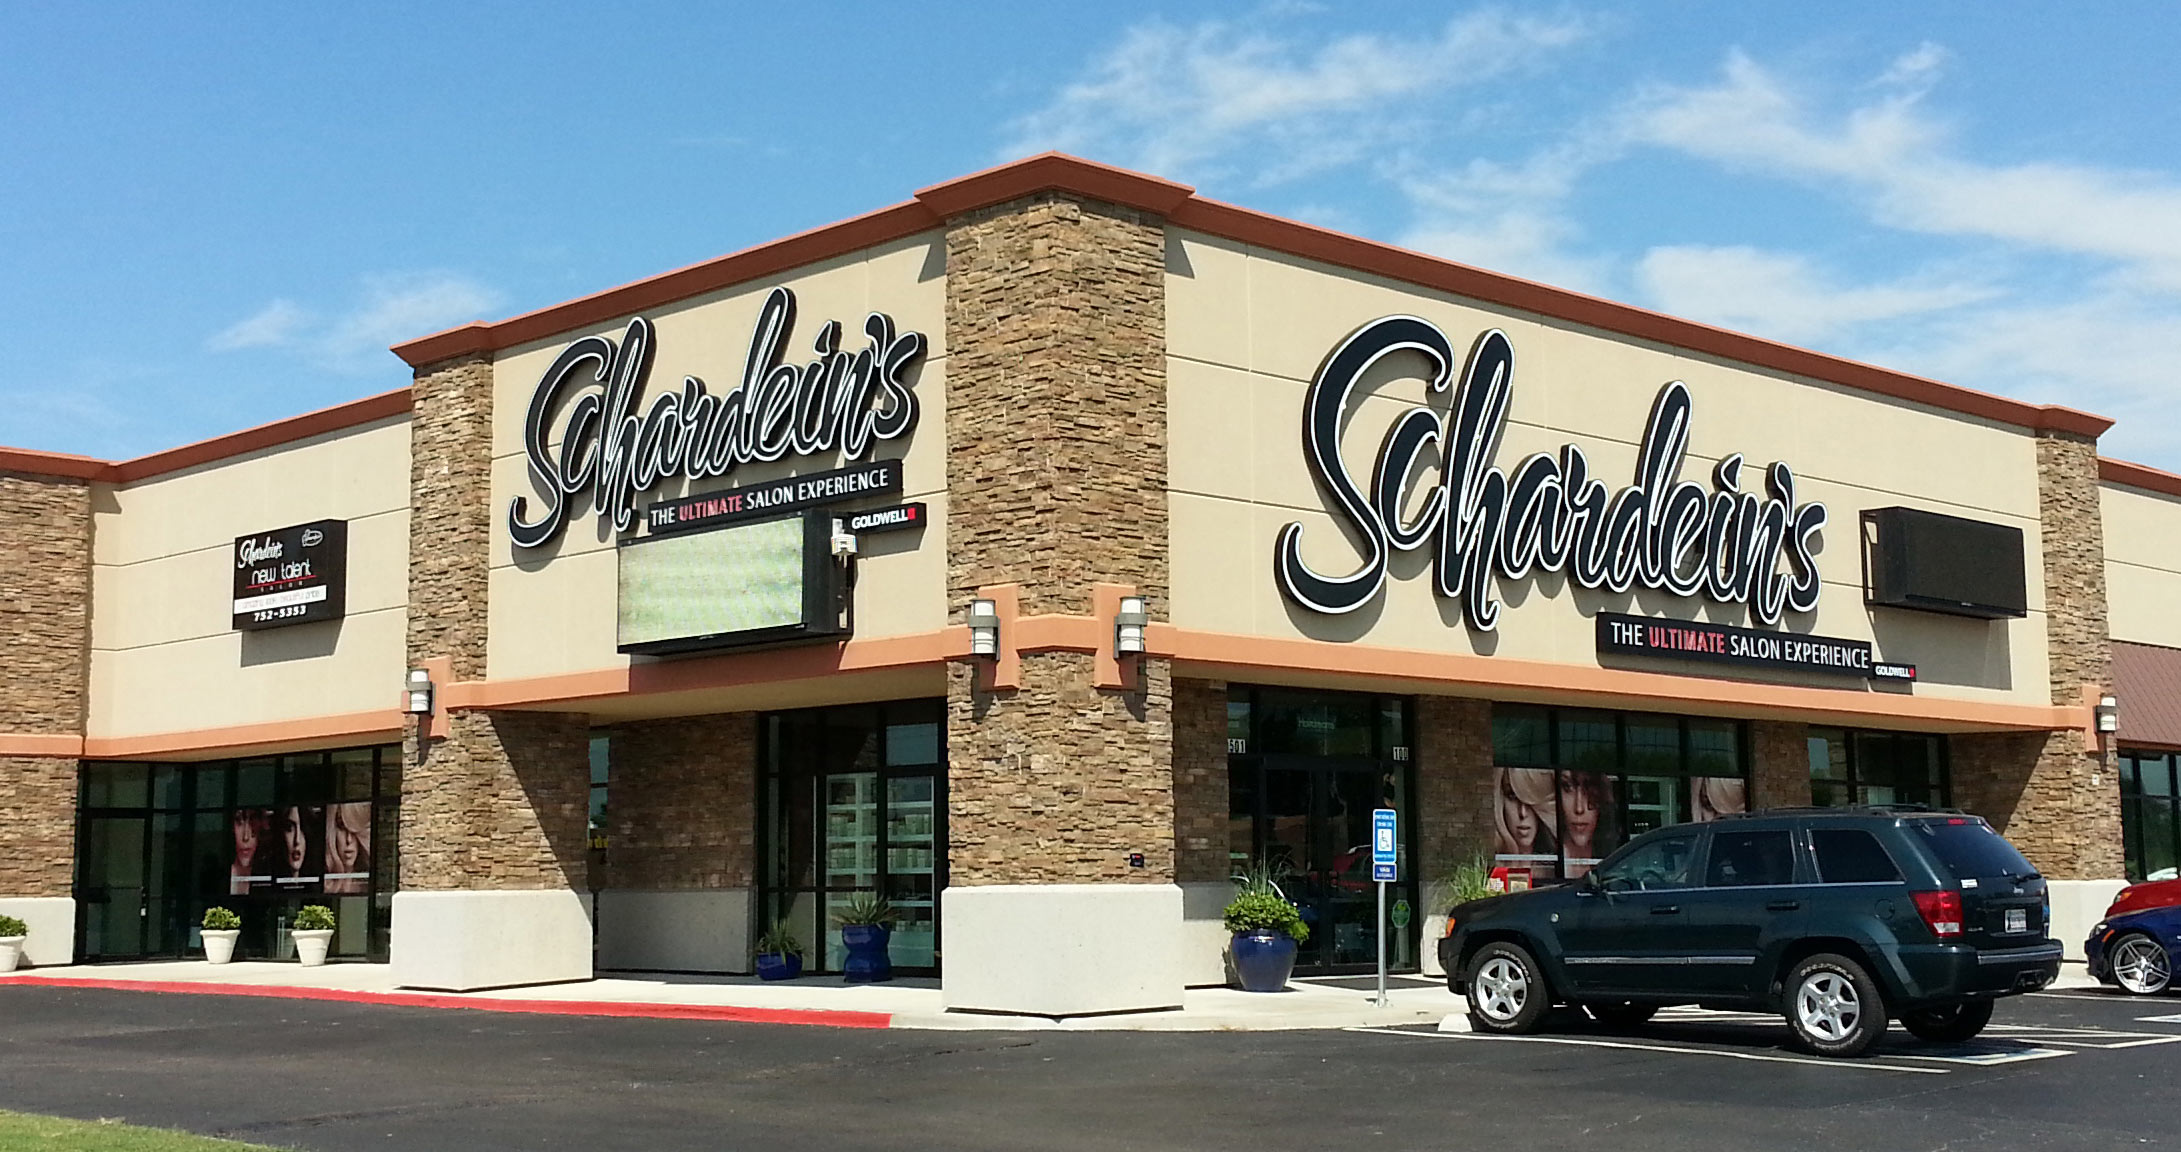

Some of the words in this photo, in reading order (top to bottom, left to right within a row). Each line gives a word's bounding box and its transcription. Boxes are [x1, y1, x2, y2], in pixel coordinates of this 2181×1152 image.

[508, 286, 926, 548] Schardein's
[1278, 313, 1828, 633] Schardein's
[651, 506, 676, 527] THE
[679, 494, 743, 522] ULTIMATE
[746, 485, 794, 510] SALON
[798, 468, 889, 501] EXPERIENCE
[851, 510, 909, 530] GOLDWELL
[251, 567, 277, 586] new
[281, 558, 312, 579] talent
[253, 604, 307, 622] 752-5353
[1610, 621, 1644, 647] THE
[1649, 626, 1726, 654] ULTIMATE
[1730, 634, 1781, 661] SALON
[1784, 639, 1869, 669] EXPERIENCE
[1875, 665, 1910, 678] GOLDWELL
